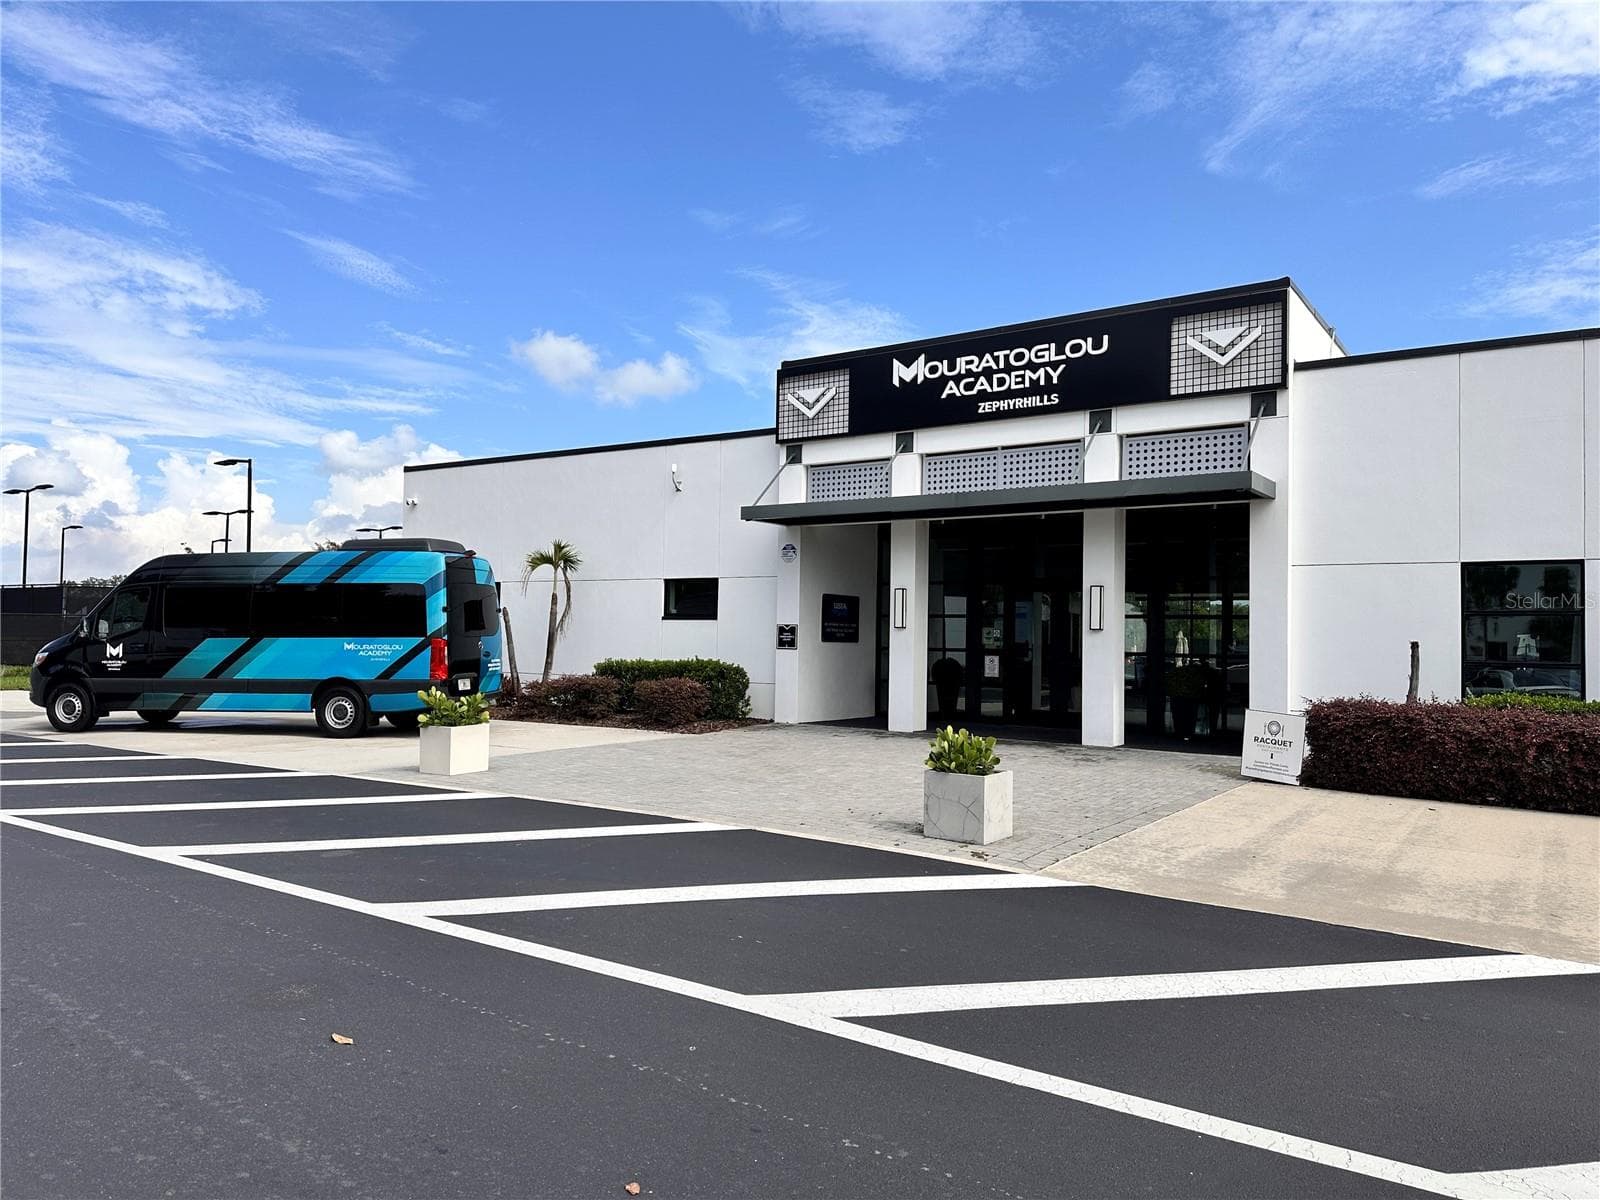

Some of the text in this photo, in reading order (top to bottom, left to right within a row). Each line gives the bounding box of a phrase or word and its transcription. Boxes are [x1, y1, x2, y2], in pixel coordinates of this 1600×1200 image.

[892, 334, 1109, 388] MOURATOGLOU
[940, 363, 1067, 399] ACADEMY
[977, 393, 1060, 414] ZEPHYRHILLS
[1253, 735, 1294, 748] RACQUET
